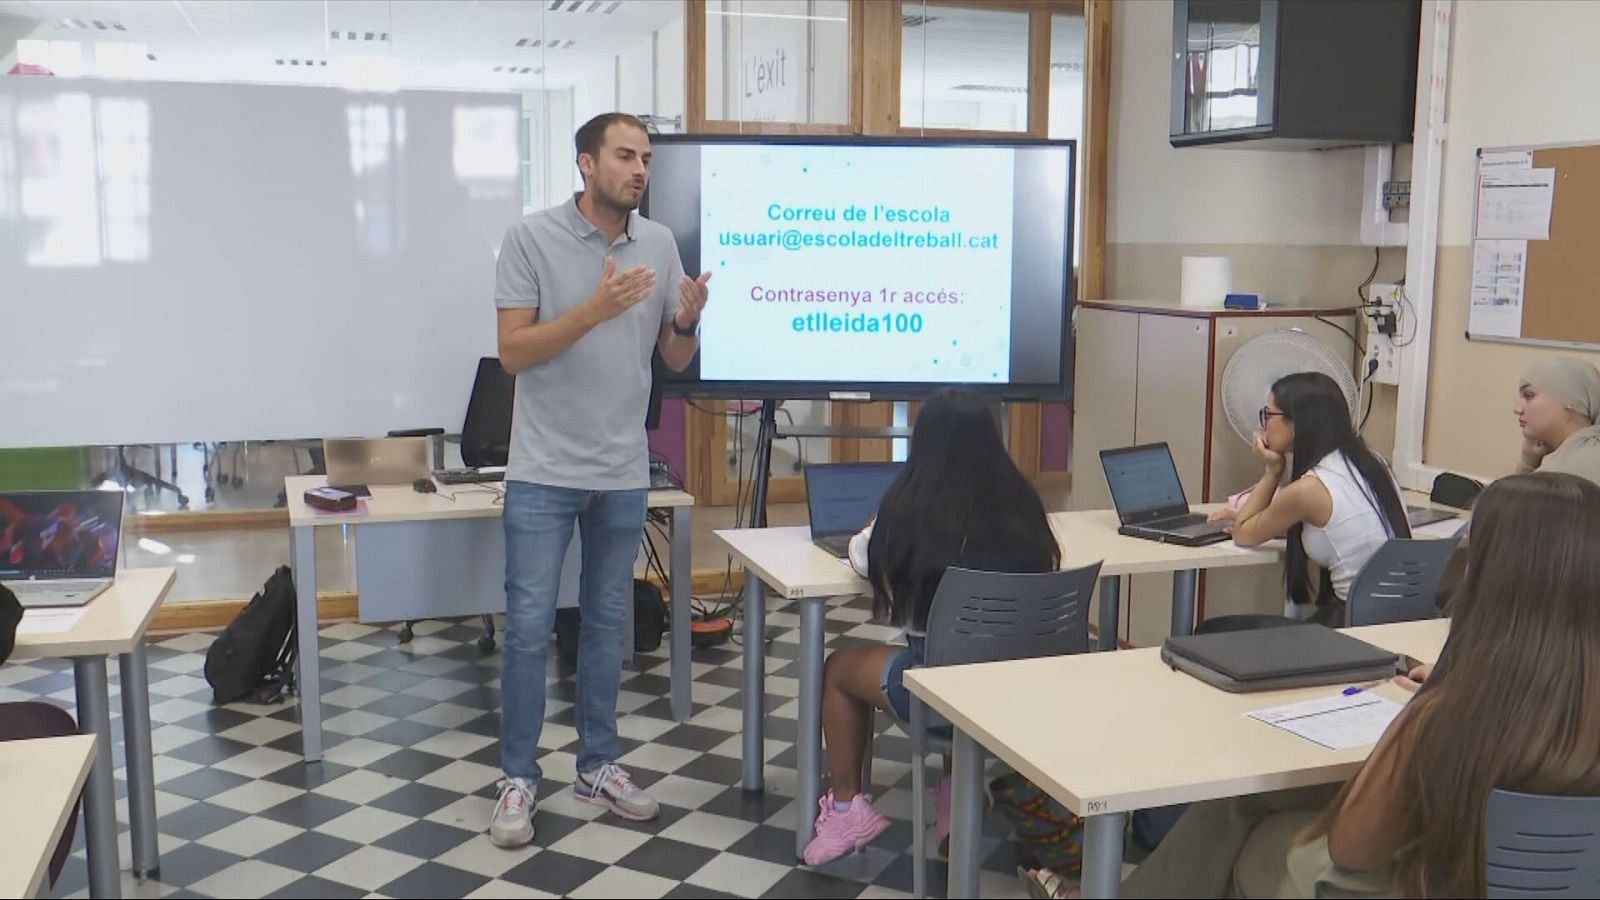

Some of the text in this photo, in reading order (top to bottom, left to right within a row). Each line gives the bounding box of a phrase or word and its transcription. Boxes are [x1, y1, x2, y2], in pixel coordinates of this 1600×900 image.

[767, 203, 950, 223] Correu de l'escola
[719, 229, 999, 251] usuari@escoladeltreball.cat
[750, 285, 964, 307] Contrasenya 1r accés:
[791, 312, 923, 333] etlleida100
